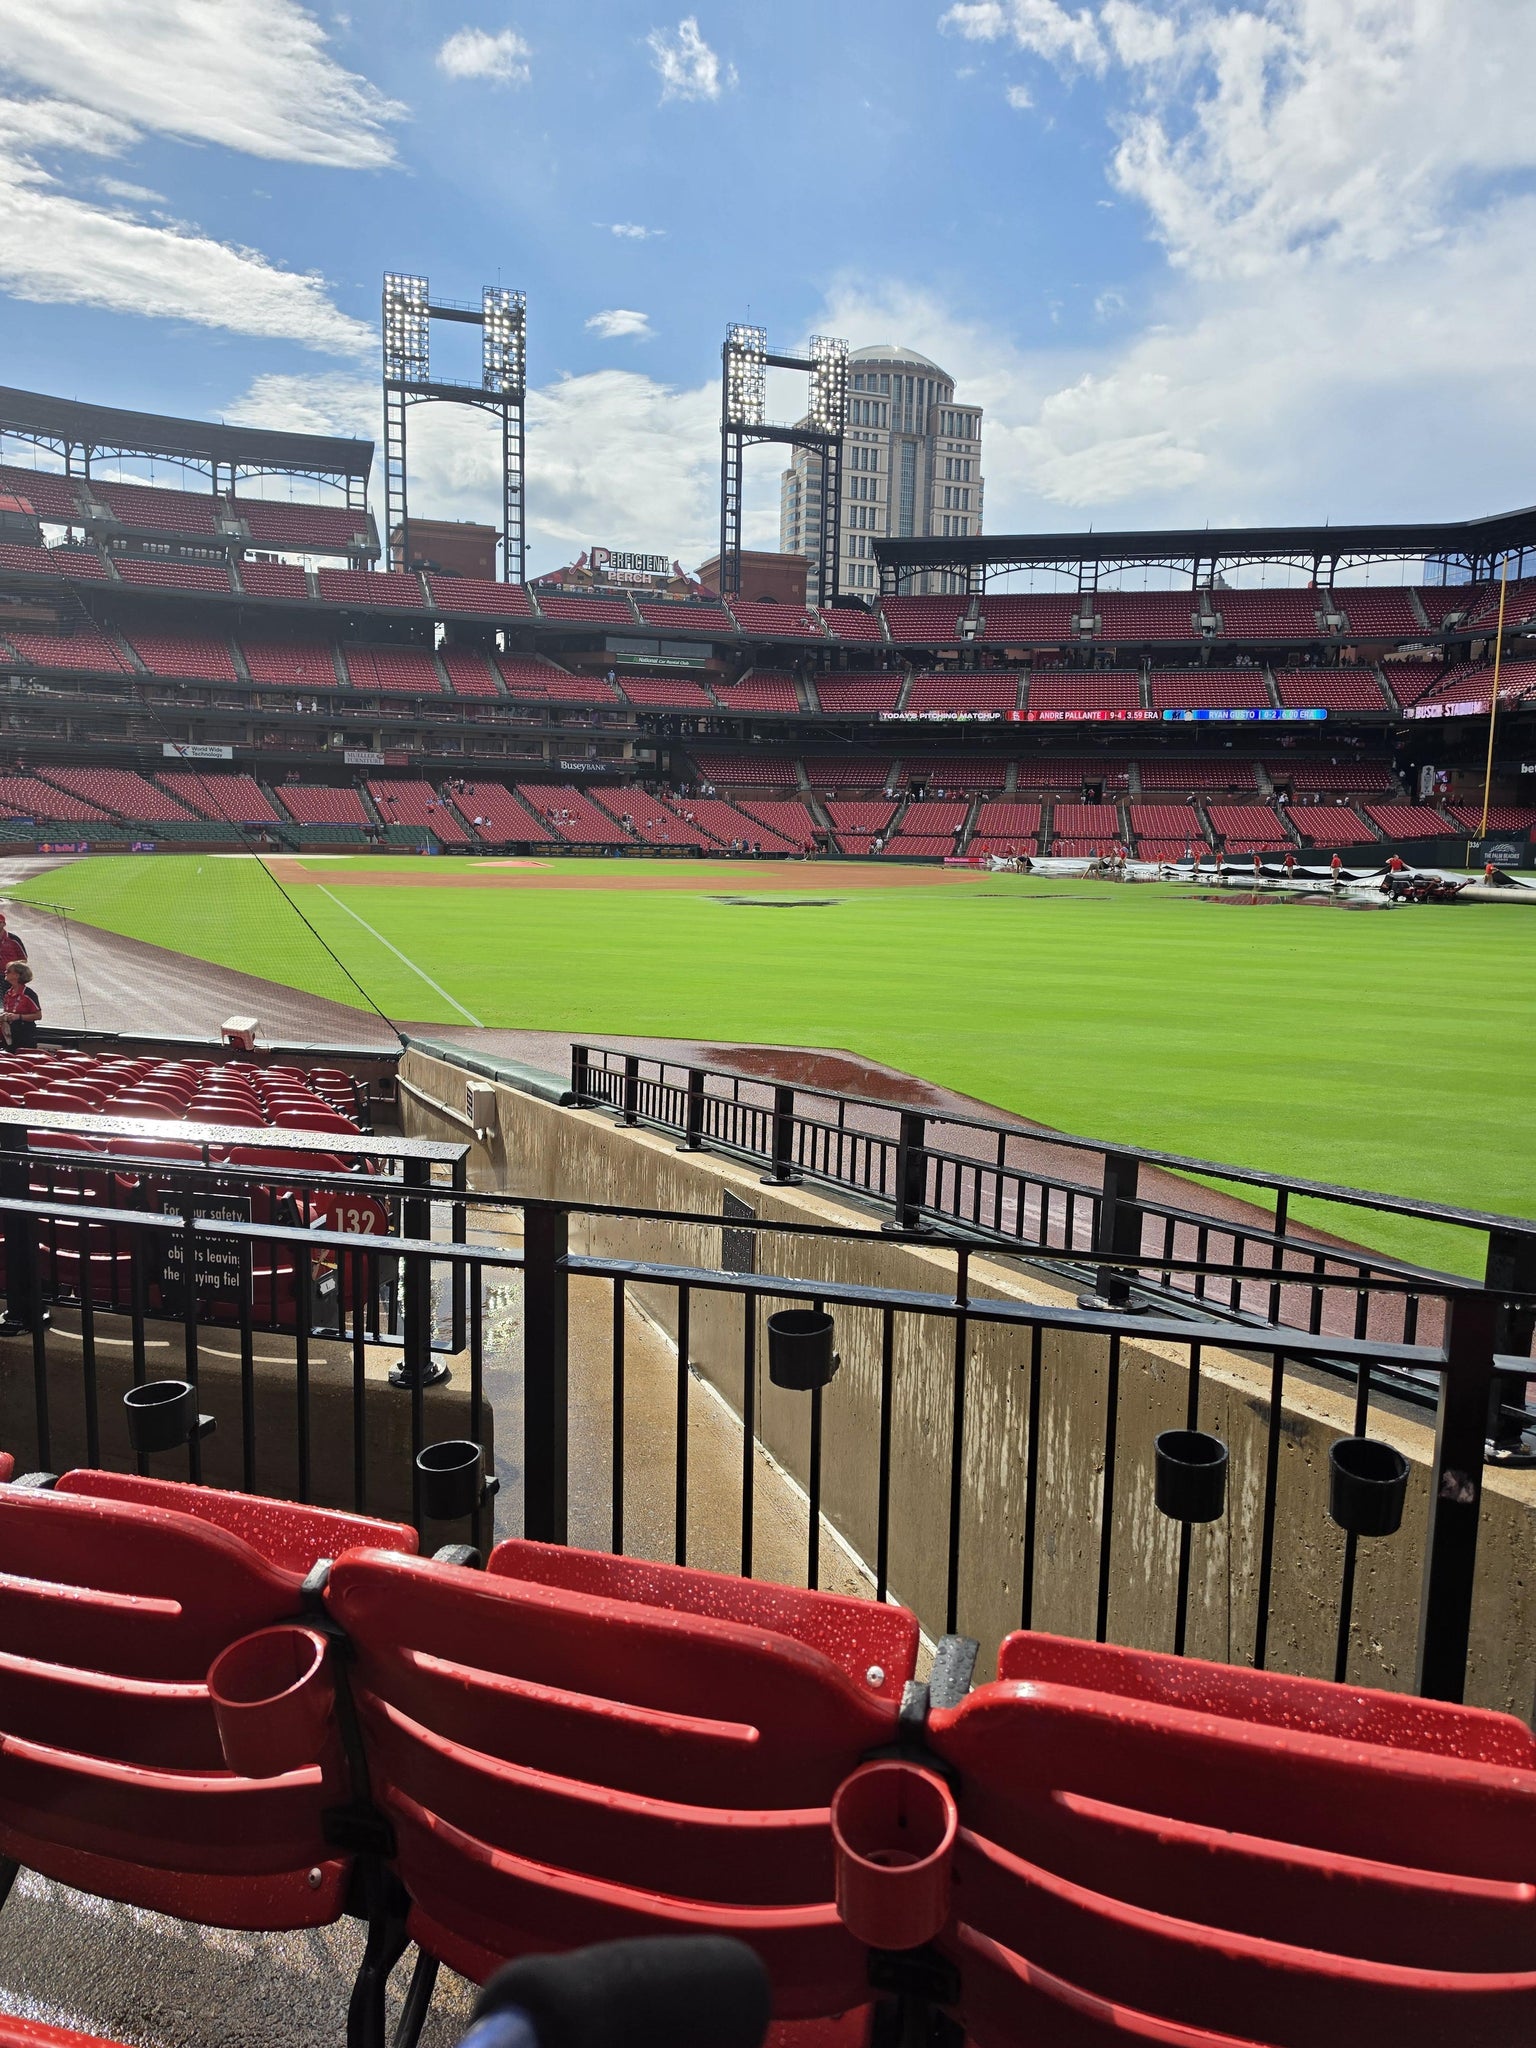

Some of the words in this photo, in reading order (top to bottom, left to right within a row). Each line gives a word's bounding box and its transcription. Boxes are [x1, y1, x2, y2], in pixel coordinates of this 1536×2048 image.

[592, 547, 669, 573] PERFICIENT
[608, 571, 652, 584] PERCH
[1209, 711, 1228, 719] RYAN
[1229, 711, 1255, 719] GUSTO
[1299, 711, 1314, 719] ERA
[163, 1203, 180, 1216] For
[336, 1208, 375, 1235] 132
[168, 1245, 203, 1263] objts
[207, 1248, 240, 1268] leavin
[163, 1266, 180, 1280] the
